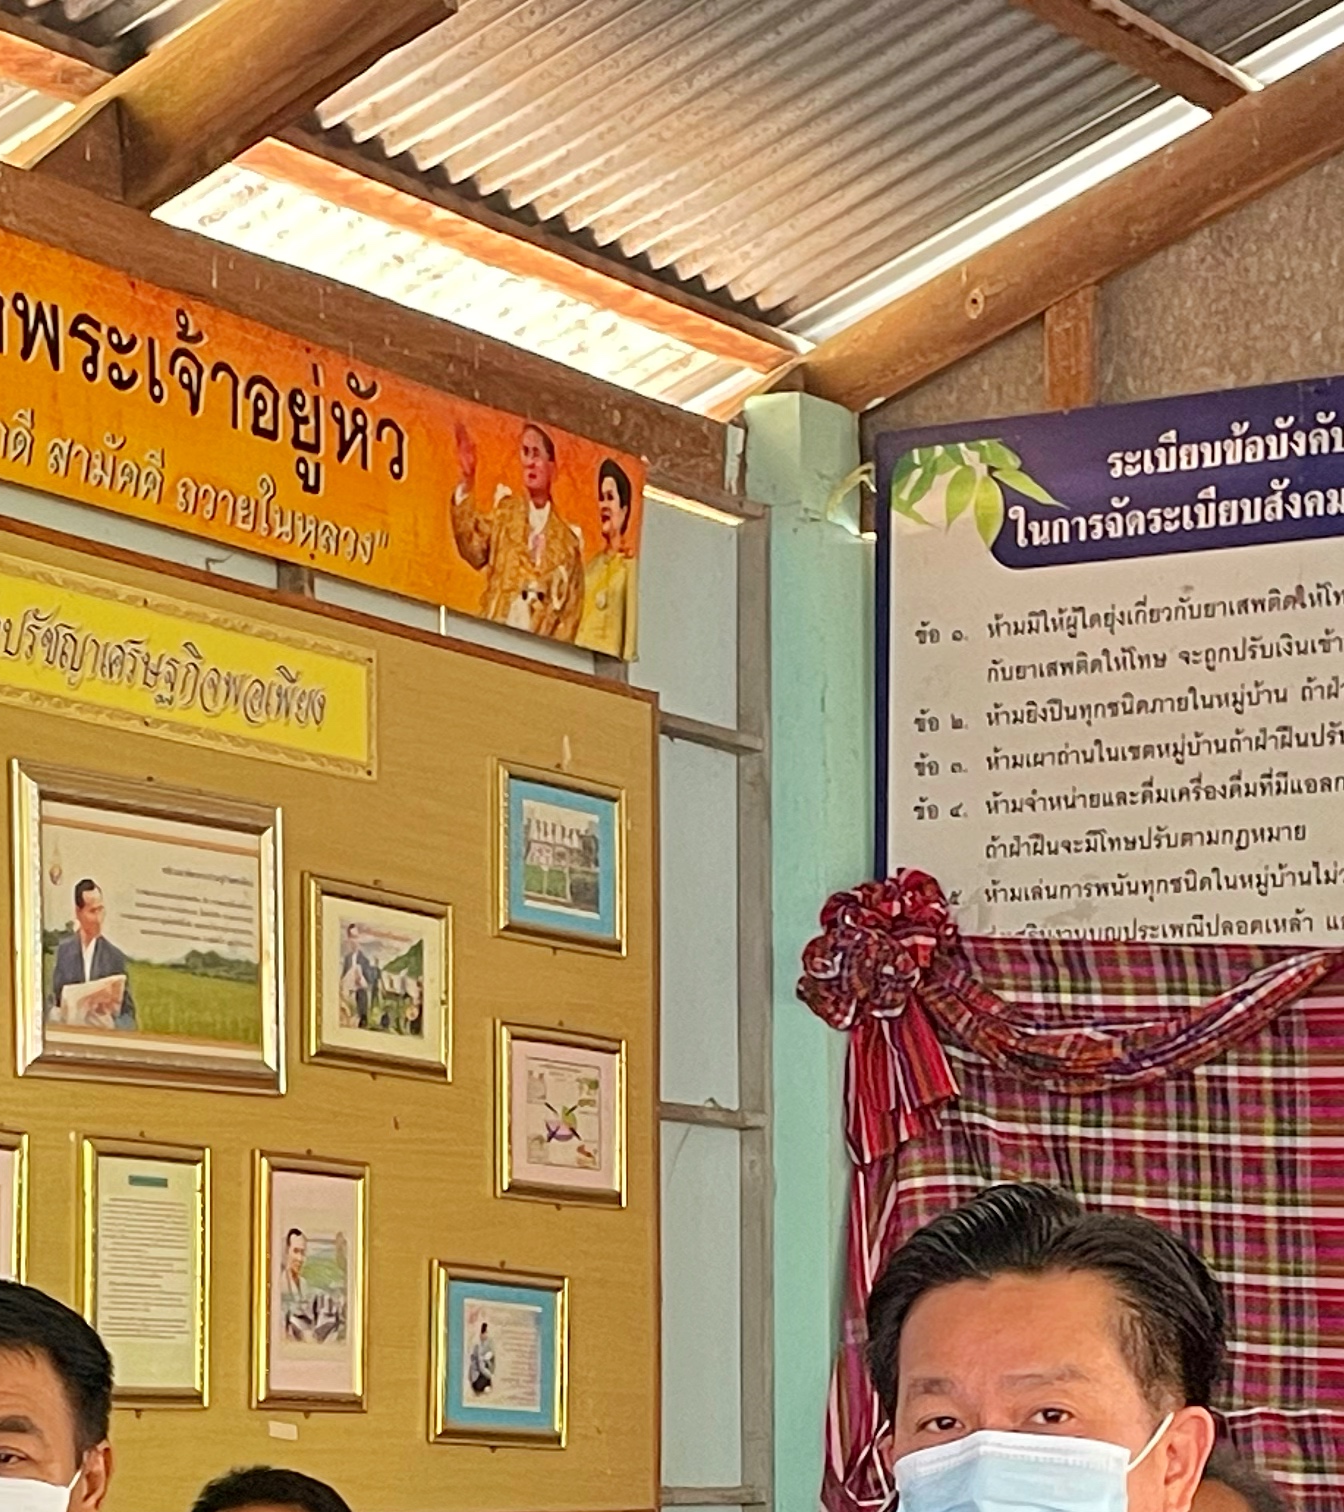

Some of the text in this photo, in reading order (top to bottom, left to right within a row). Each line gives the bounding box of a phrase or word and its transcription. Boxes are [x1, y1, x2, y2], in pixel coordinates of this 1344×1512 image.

[47, 431, 165, 504] สามัคคี
[176, 472, 390, 566] ถวายในหลวง"
[915, 620, 941, 645] ข้อ
[986, 645, 1168, 683] กับยาเสพติดให้โทษ
[913, 708, 940, 733] ข้อ
[985, 680, 1288, 728] ห้ามยิงปืนทุกชนิดภายในหมู่บ้าน
[913, 752, 940, 777] ข้อ
[913, 796, 940, 821] ข้อ
